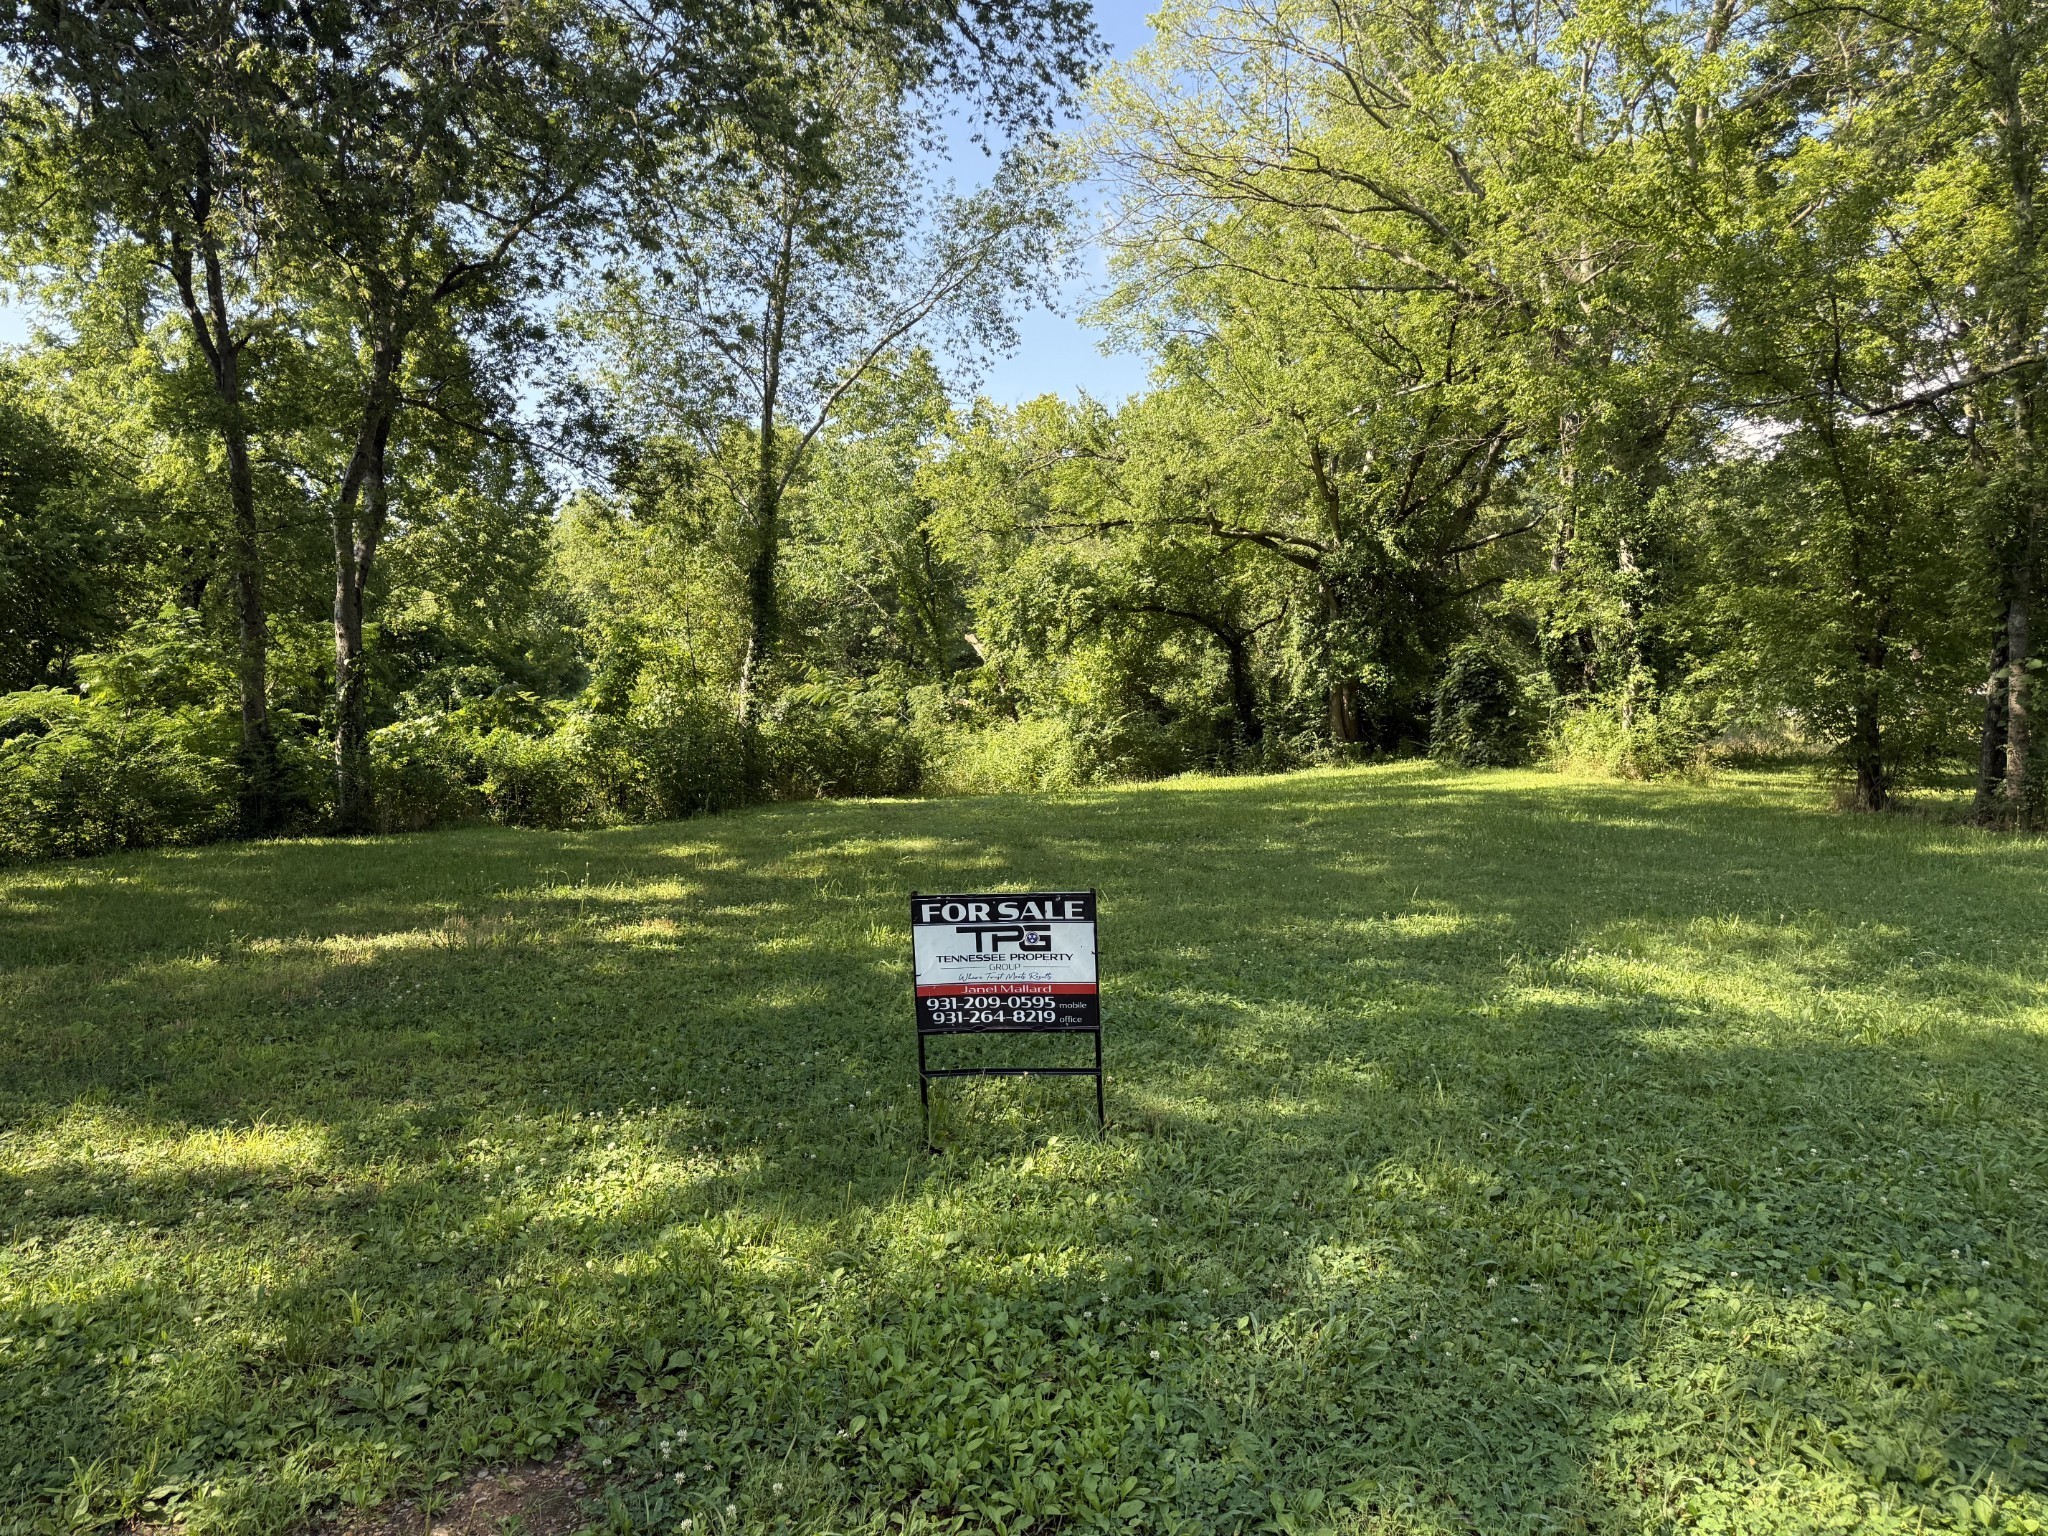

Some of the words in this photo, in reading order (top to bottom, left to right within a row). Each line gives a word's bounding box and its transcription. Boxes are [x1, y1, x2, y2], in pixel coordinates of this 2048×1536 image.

[921, 902, 991, 922] FOR
[997, 900, 1085, 920] SALE
[956, 925, 1051, 952] TPG
[936, 953, 1006, 963] TENNESSEE
[1010, 953, 1074, 962] PROPERTY
[989, 963, 1021, 971] GROUP
[958, 973, 983, 981] Where
[986, 972, 1004, 980] Trust
[1005, 972, 1026, 980] Meets
[1028, 972, 1053, 981] Results
[961, 985, 997, 994] Janel
[1000, 984, 1052, 994] Mallard
[926, 996, 1056, 1011] 931-209-0595
[1059, 1001, 1088, 1009] mobile
[932, 1010, 1056, 1024] 931-264-8219
